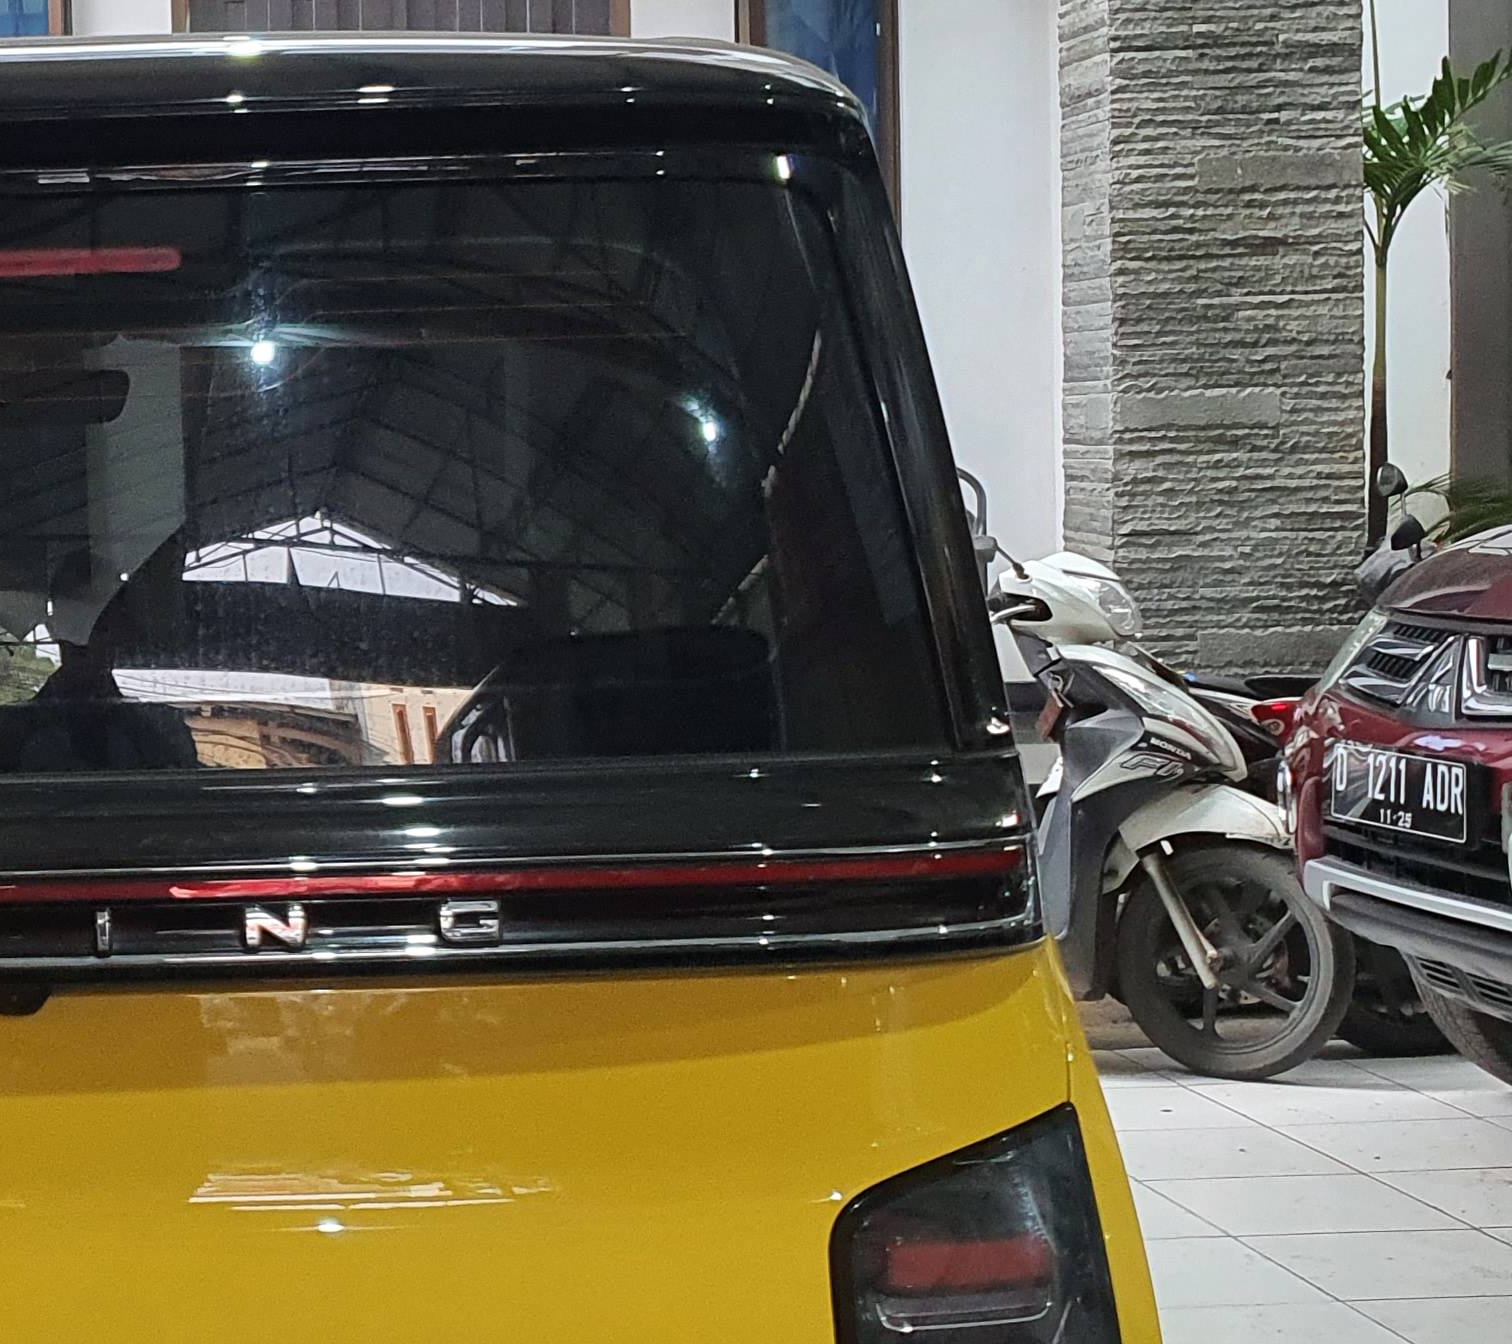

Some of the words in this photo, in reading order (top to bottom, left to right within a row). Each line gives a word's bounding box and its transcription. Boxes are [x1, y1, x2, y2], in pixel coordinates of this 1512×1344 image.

[1336, 748, 1348, 792] D
[1368, 752, 1408, 806] 1211
[1422, 762, 1465, 816] ADR
